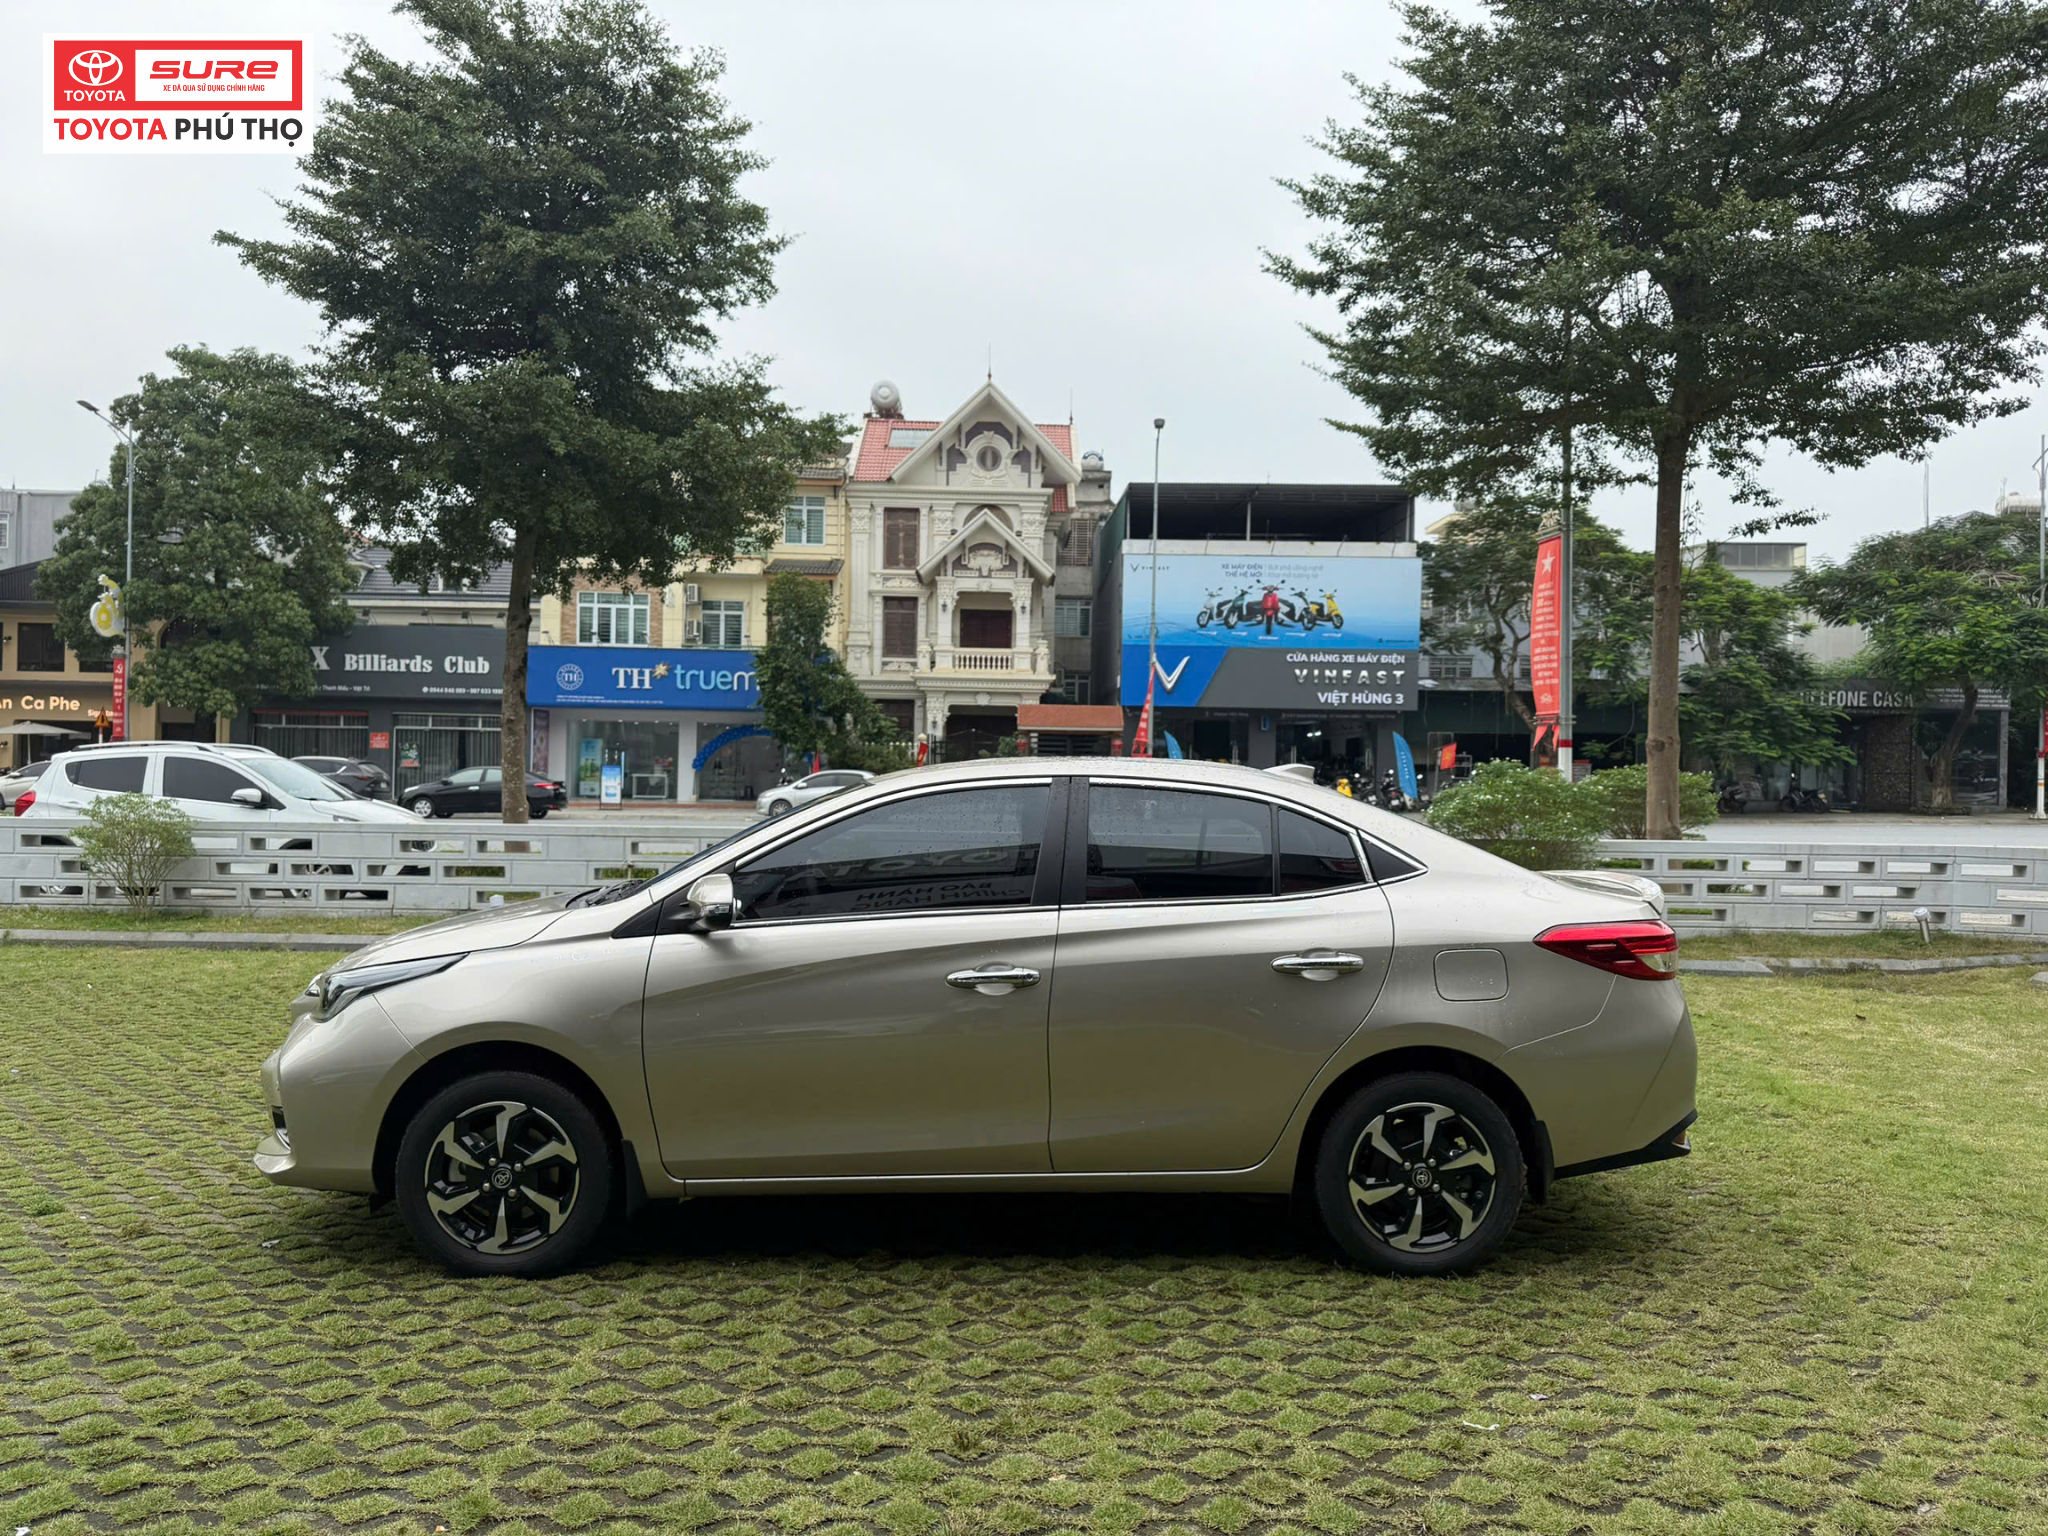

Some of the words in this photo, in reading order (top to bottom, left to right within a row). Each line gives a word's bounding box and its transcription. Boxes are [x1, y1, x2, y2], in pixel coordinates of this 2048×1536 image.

[310, 646, 330, 671] X
[344, 653, 433, 673] Billiards
[444, 655, 490, 674] Club
[1286, 651, 1308, 662] CỬA
[1310, 651, 1340, 663] HÀNG
[1341, 654, 1355, 663] XE
[1356, 653, 1379, 664] MÁY
[1380, 653, 1405, 666] ĐIỆN
[612, 667, 653, 690] TH
[1294, 669, 1405, 685] VINFAST
[21, 696, 45, 710] Ca
[49, 696, 81, 711] Phe
[1317, 689, 1349, 707] VIỆT
[1351, 690, 1392, 704] HÙNG
[1395, 693, 1404, 705] 3
